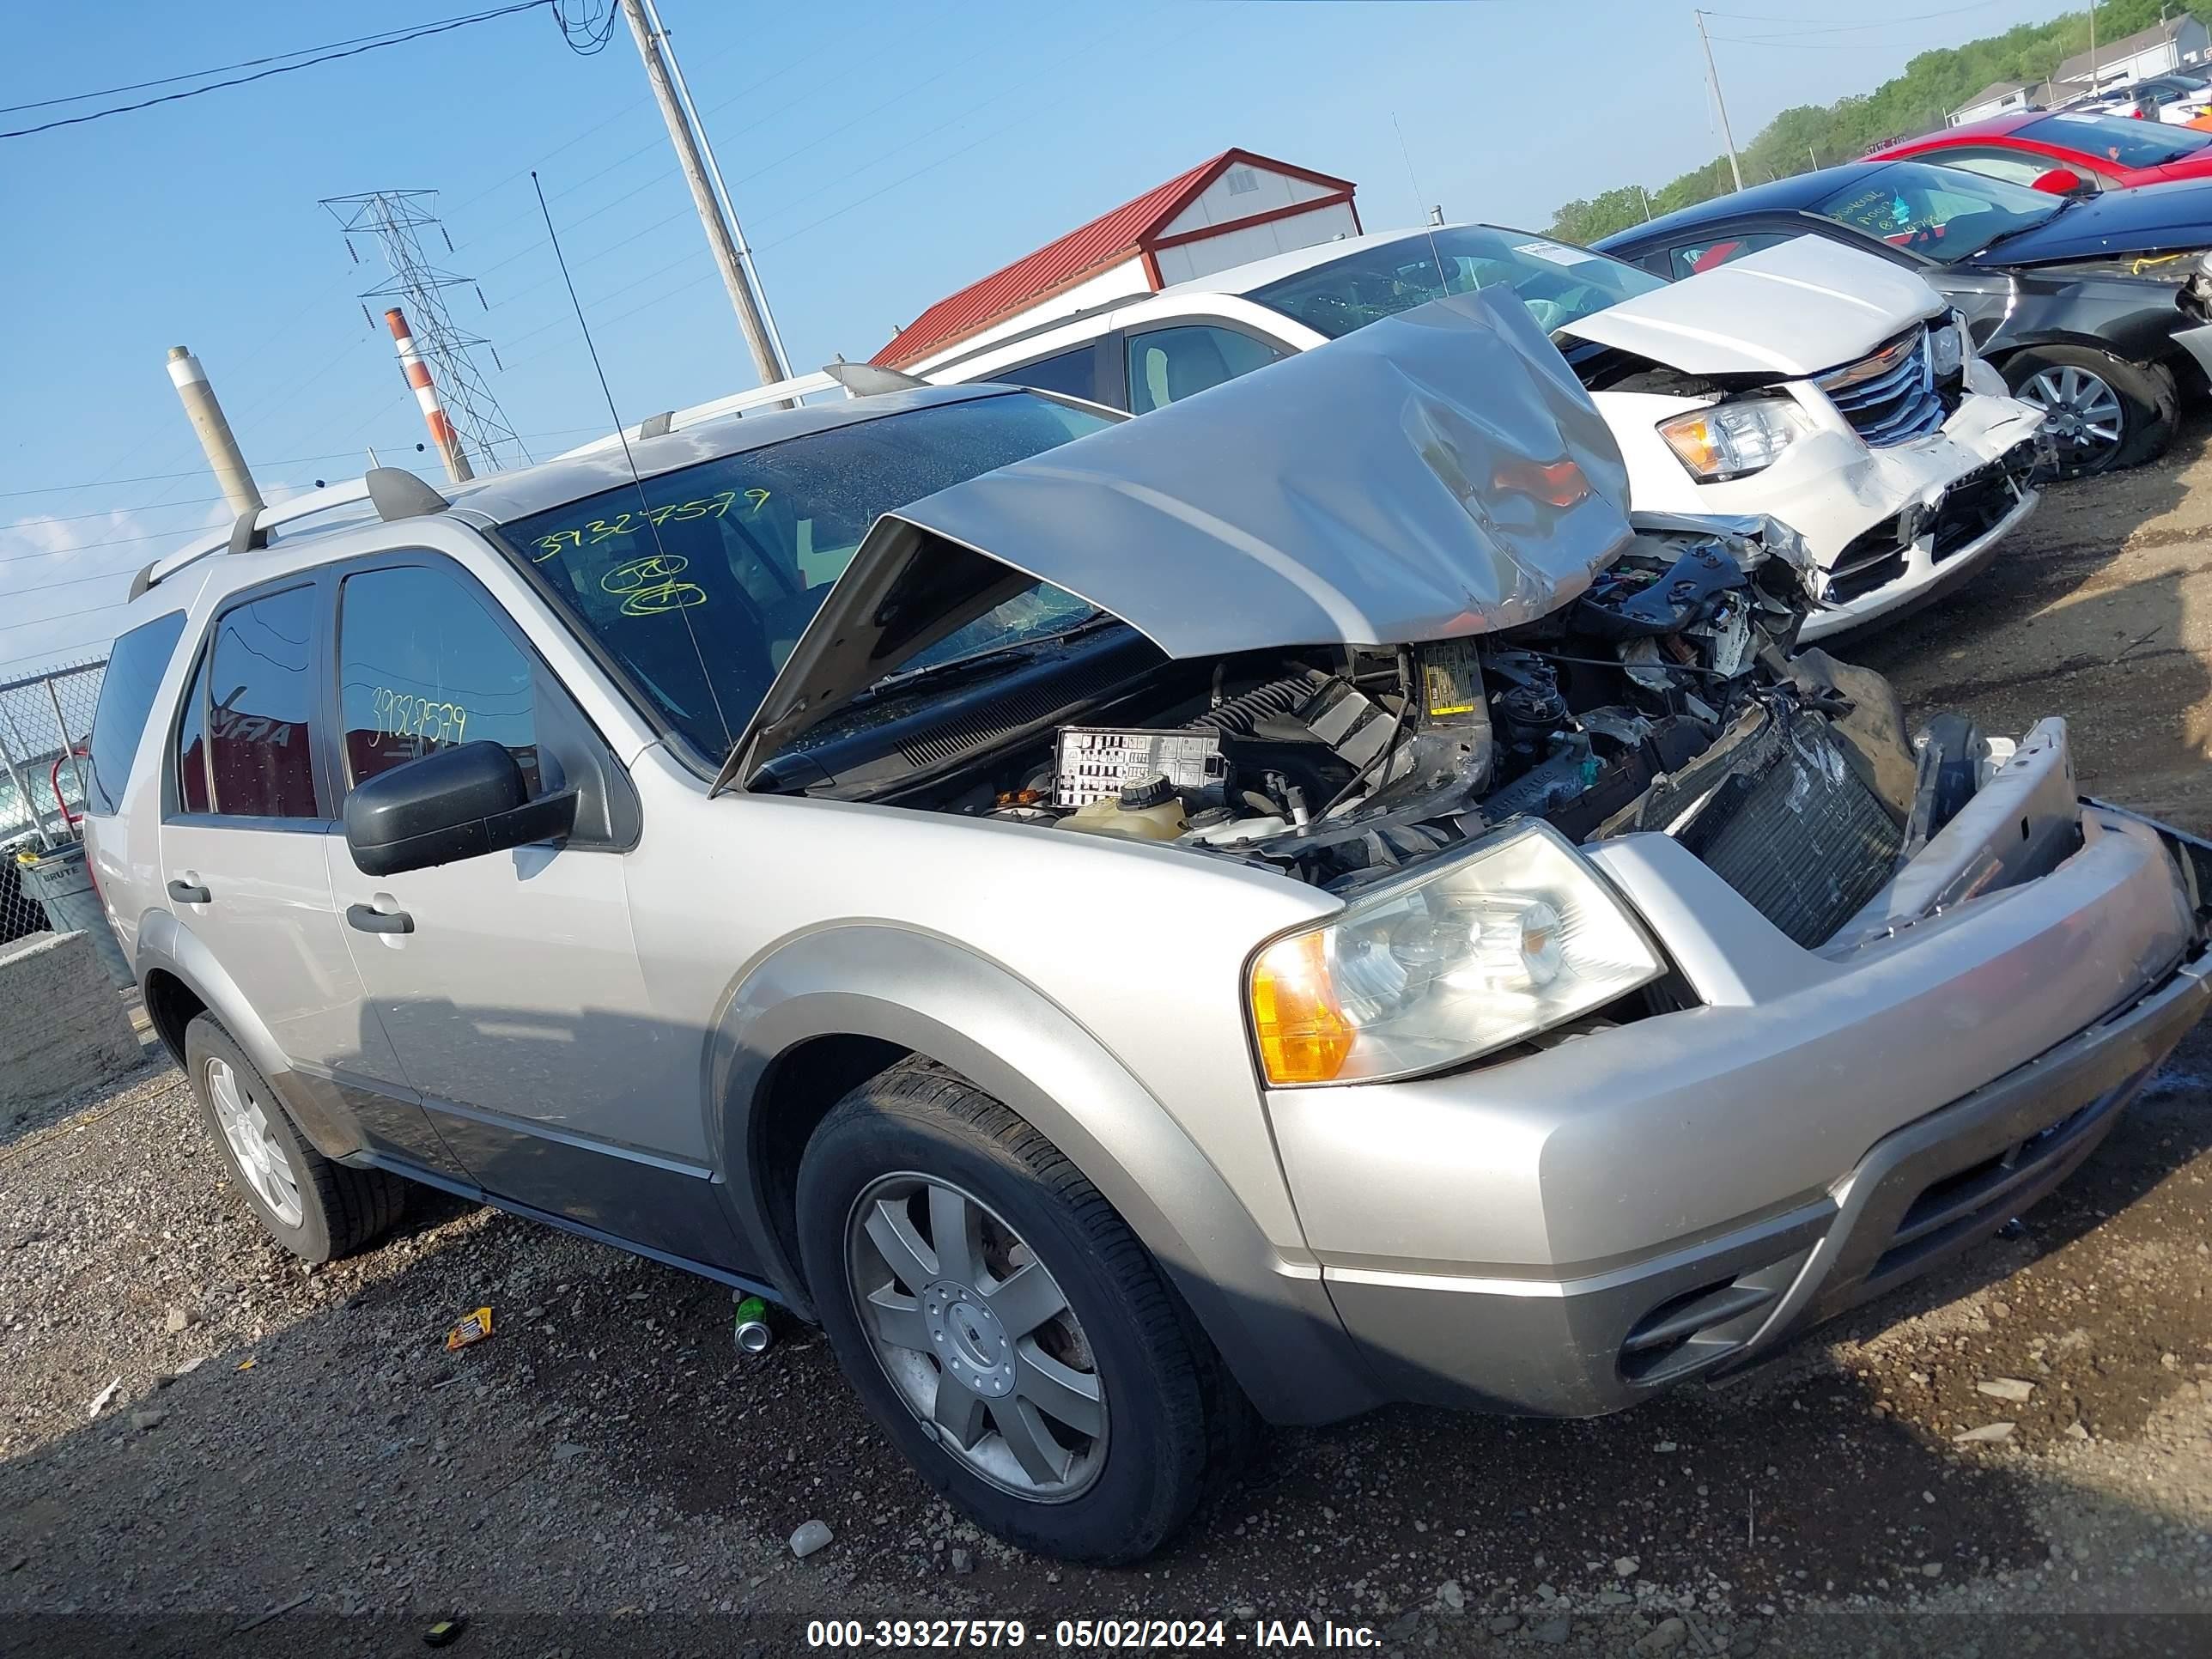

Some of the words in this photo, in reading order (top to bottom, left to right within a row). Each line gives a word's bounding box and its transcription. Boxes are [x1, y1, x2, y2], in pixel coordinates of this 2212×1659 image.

[530, 488, 771, 563] 39327579
[368, 686, 466, 747] 39327579
[43, 866, 80, 882] BRUTE
